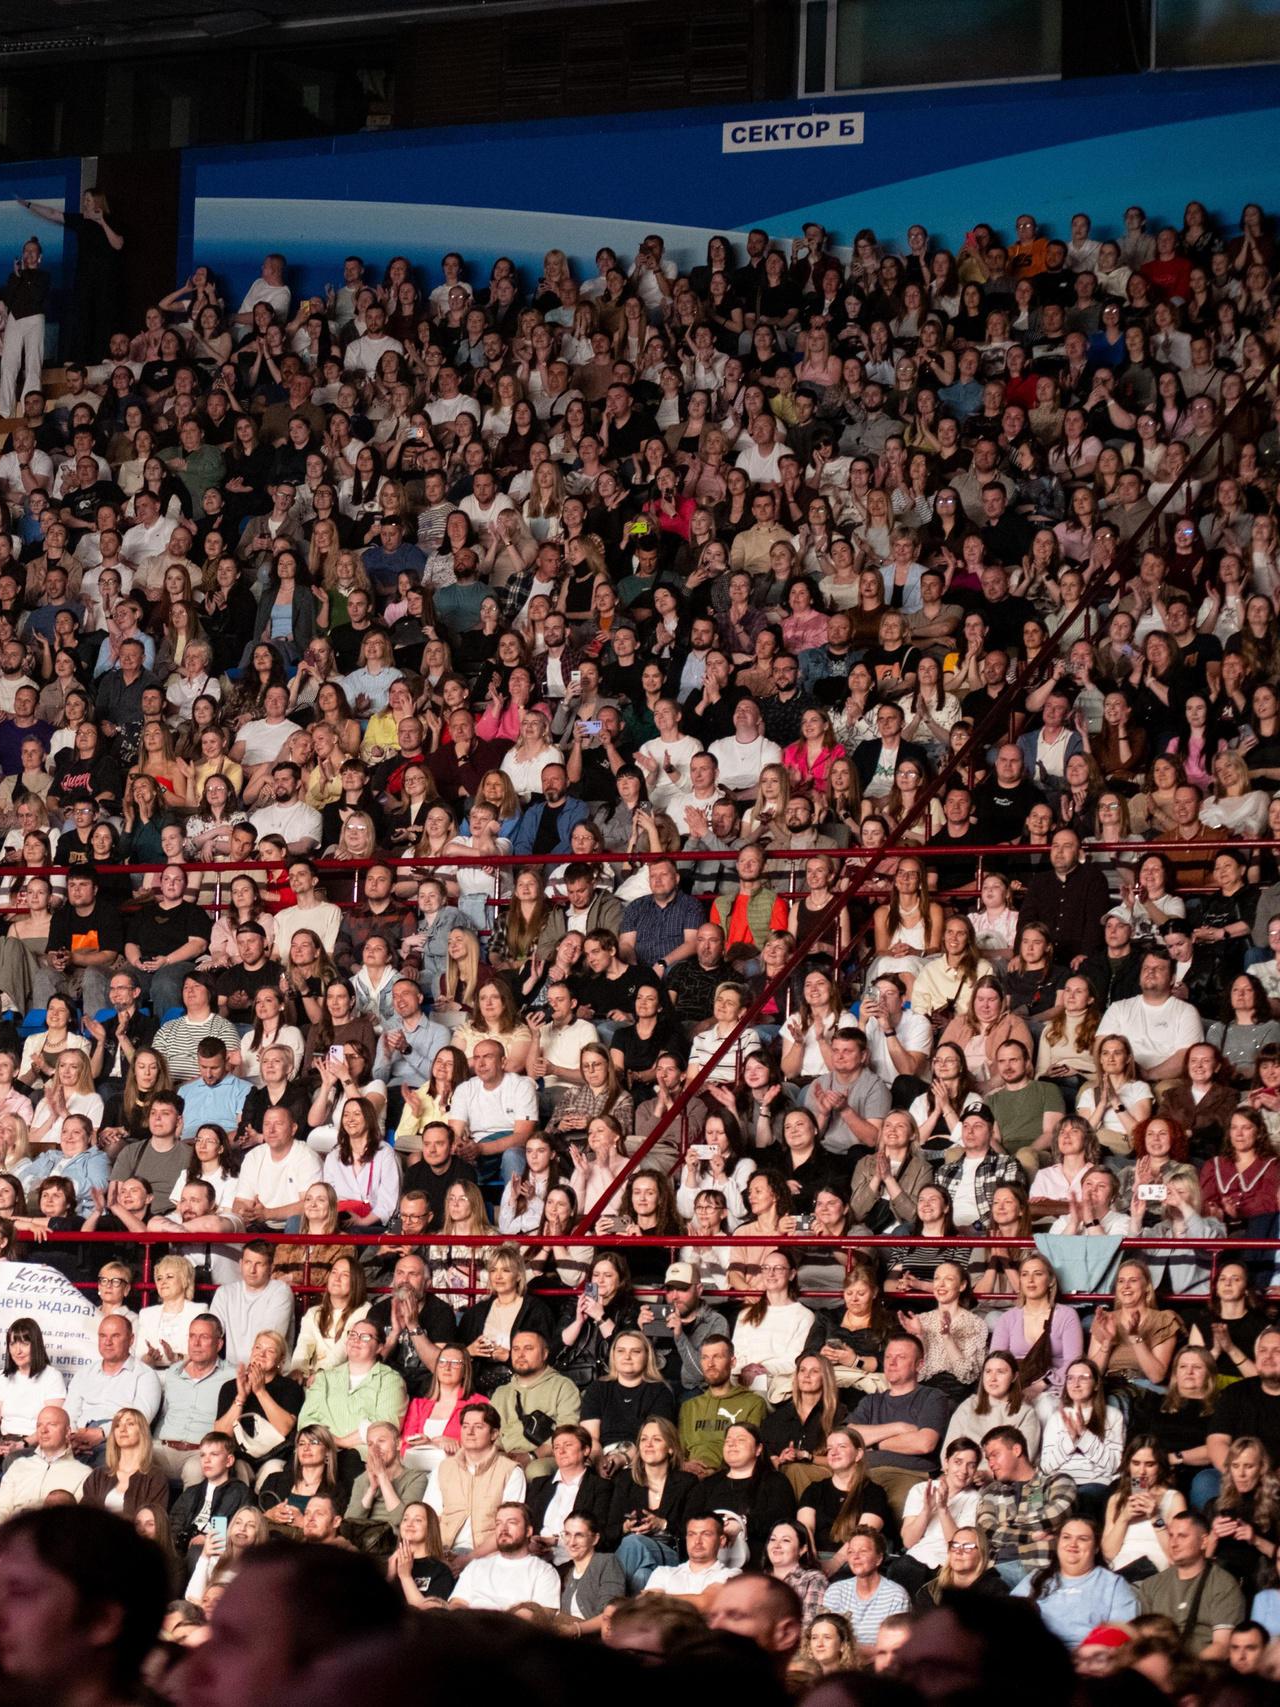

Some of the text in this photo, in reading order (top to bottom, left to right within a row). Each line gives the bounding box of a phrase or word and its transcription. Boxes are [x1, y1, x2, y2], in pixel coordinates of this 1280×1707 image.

[731, 119, 855, 143] СЕКТОР Б
[37, 1300, 96, 1317] ждала!
